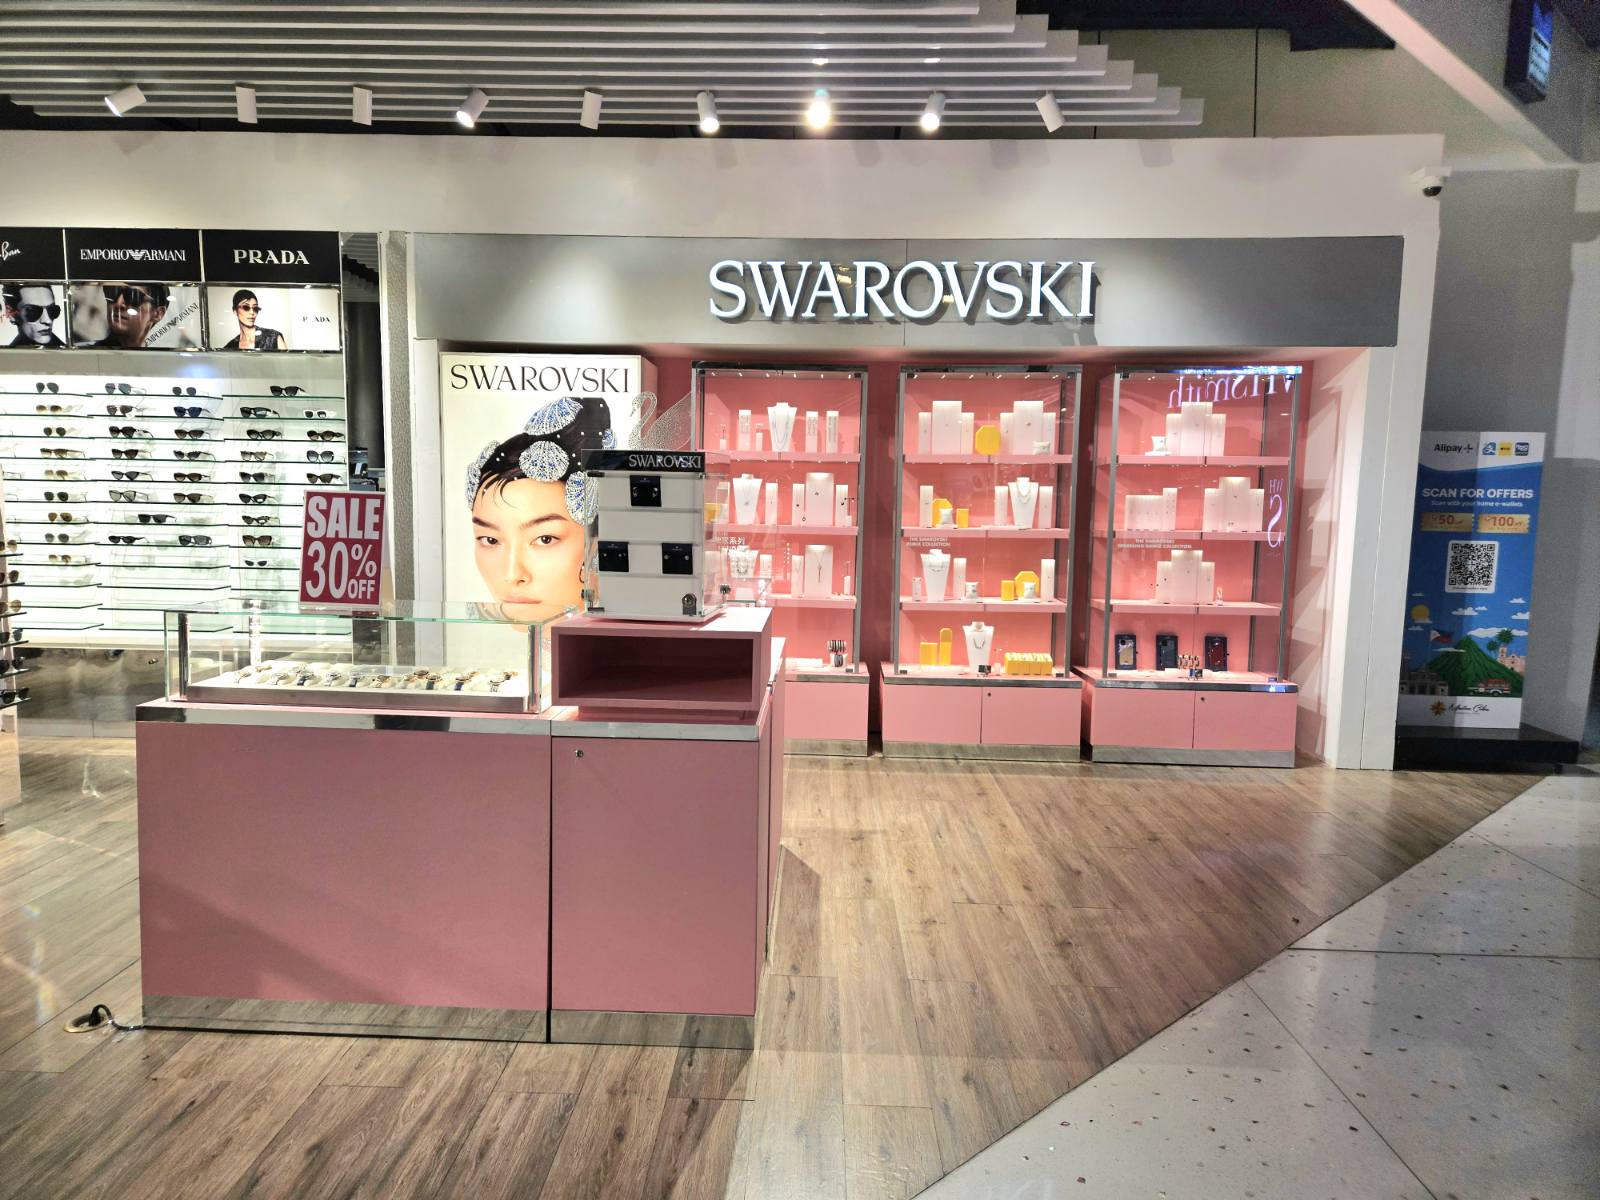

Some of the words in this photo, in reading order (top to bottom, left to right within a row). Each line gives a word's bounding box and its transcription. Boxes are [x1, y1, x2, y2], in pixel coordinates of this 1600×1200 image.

[80, 248, 129, 261] EMPORIO
[144, 249, 186, 262] ARMANI
[233, 249, 309, 265] PRADA
[708, 259, 1096, 321] SWAROVSKI
[450, 363, 631, 393] SWAROVSKI
[628, 454, 702, 469] SWAROVSKI
[1422, 488, 1457, 498] SCAN
[1460, 488, 1484, 498] FOR
[1486, 489, 1534, 499] OFFERS
[306, 495, 381, 540] SALE
[1492, 516, 1514, 527] 100
[305, 540, 377, 599] 30%
[347, 578, 376, 599] OFF
